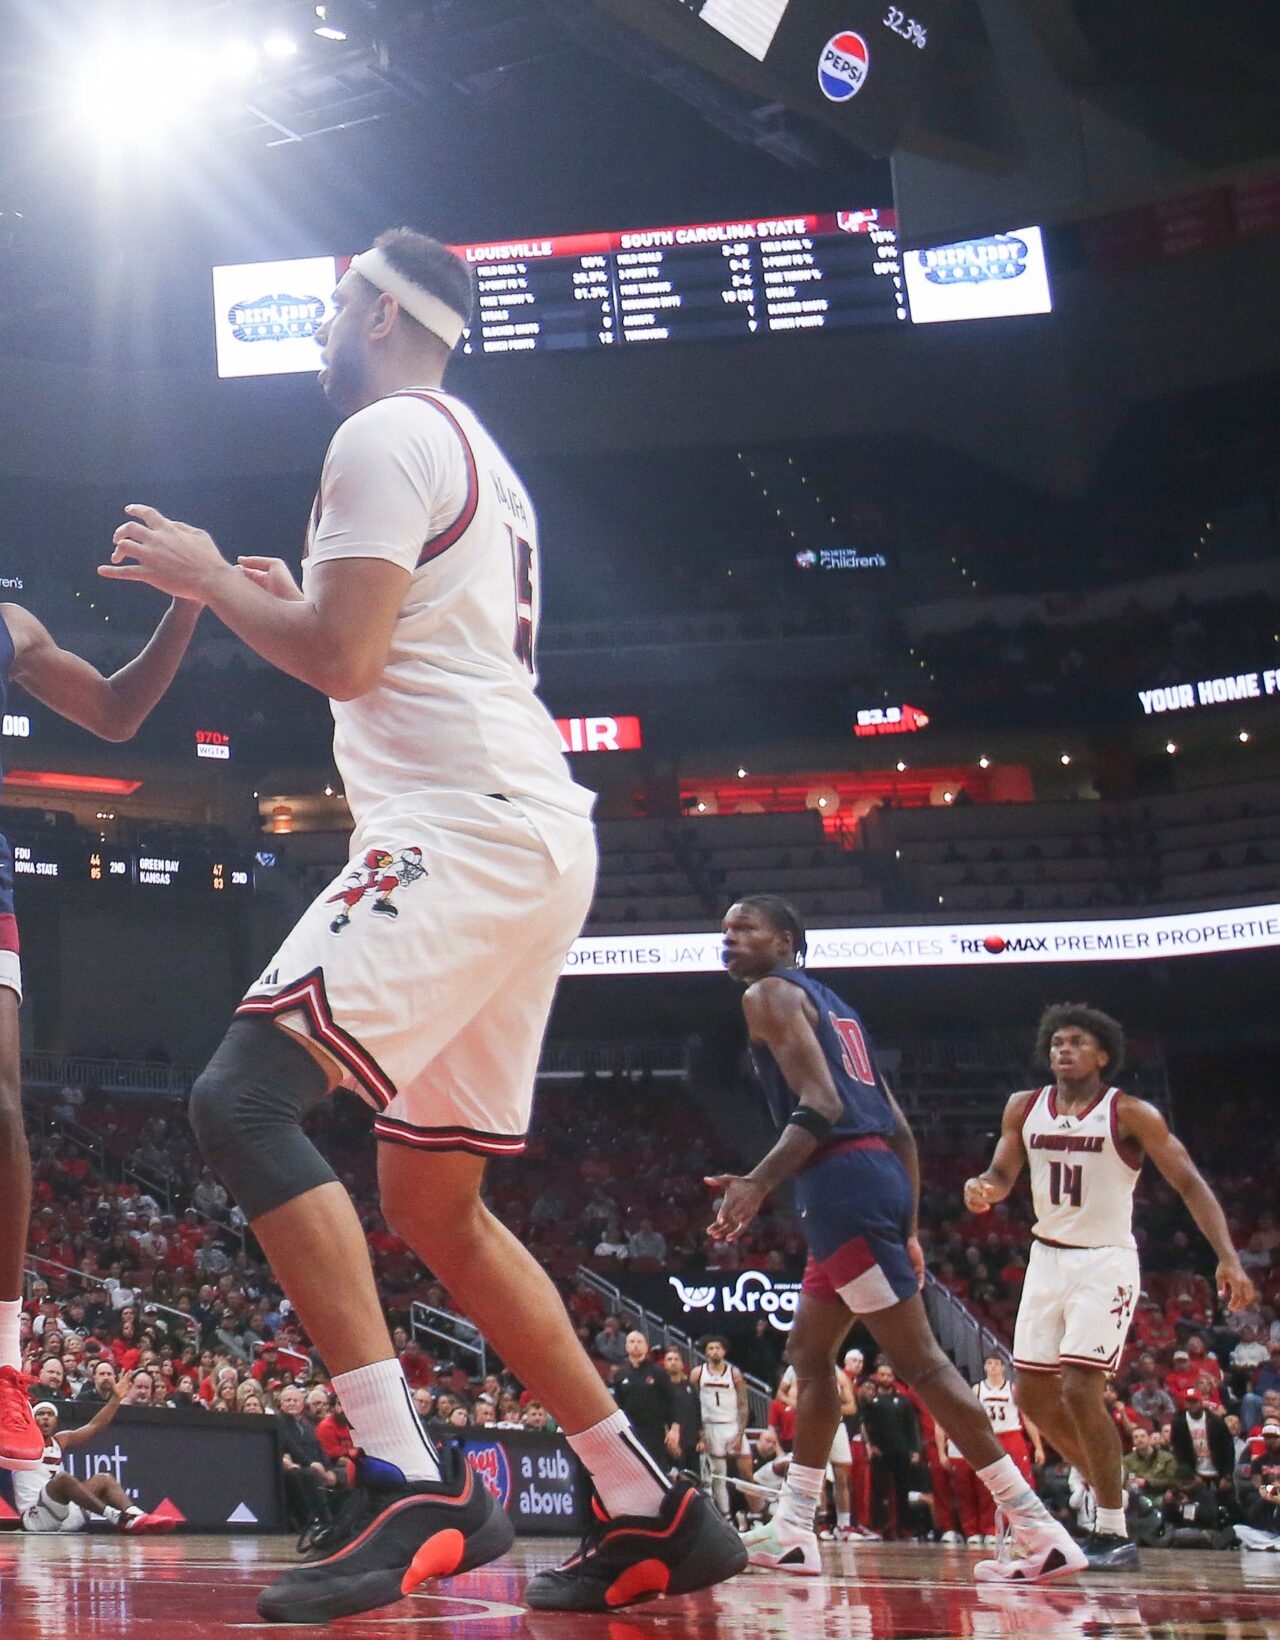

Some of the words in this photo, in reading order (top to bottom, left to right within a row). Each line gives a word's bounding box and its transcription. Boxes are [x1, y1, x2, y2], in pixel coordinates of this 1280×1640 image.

[883, 6, 926, 49] 32.3%
[824, 50, 862, 84] PEPSI
[621, 231, 674, 248] SOUTH
[676, 224, 756, 244] CAROLINA
[757, 219, 807, 237] STATE
[466, 242, 552, 262] LOUISVILLE
[1138, 683, 1195, 715] YOUR
[1197, 672, 1261, 706] HOME
[14, 847, 31, 860] FDU
[15, 861, 35, 874] IOWA
[36, 863, 59, 876] STATE
[109, 861, 126, 874] 2ND
[139, 858, 165, 872] GREEN
[165, 860, 180, 872] BAY
[139, 871, 171, 885] KANSAS
[231, 871, 248, 884] 2ND
[813, 940, 943, 958] ASSOCIATES
[1055, 933, 1150, 951] PREMIER
[671, 947, 704, 963] JAY
[1029, 1133, 1106, 1154] LOUISVILLE
[1048, 1161, 1083, 1207] 14
[521, 1456, 533, 1478] a
[538, 1449, 570, 1479] sub
